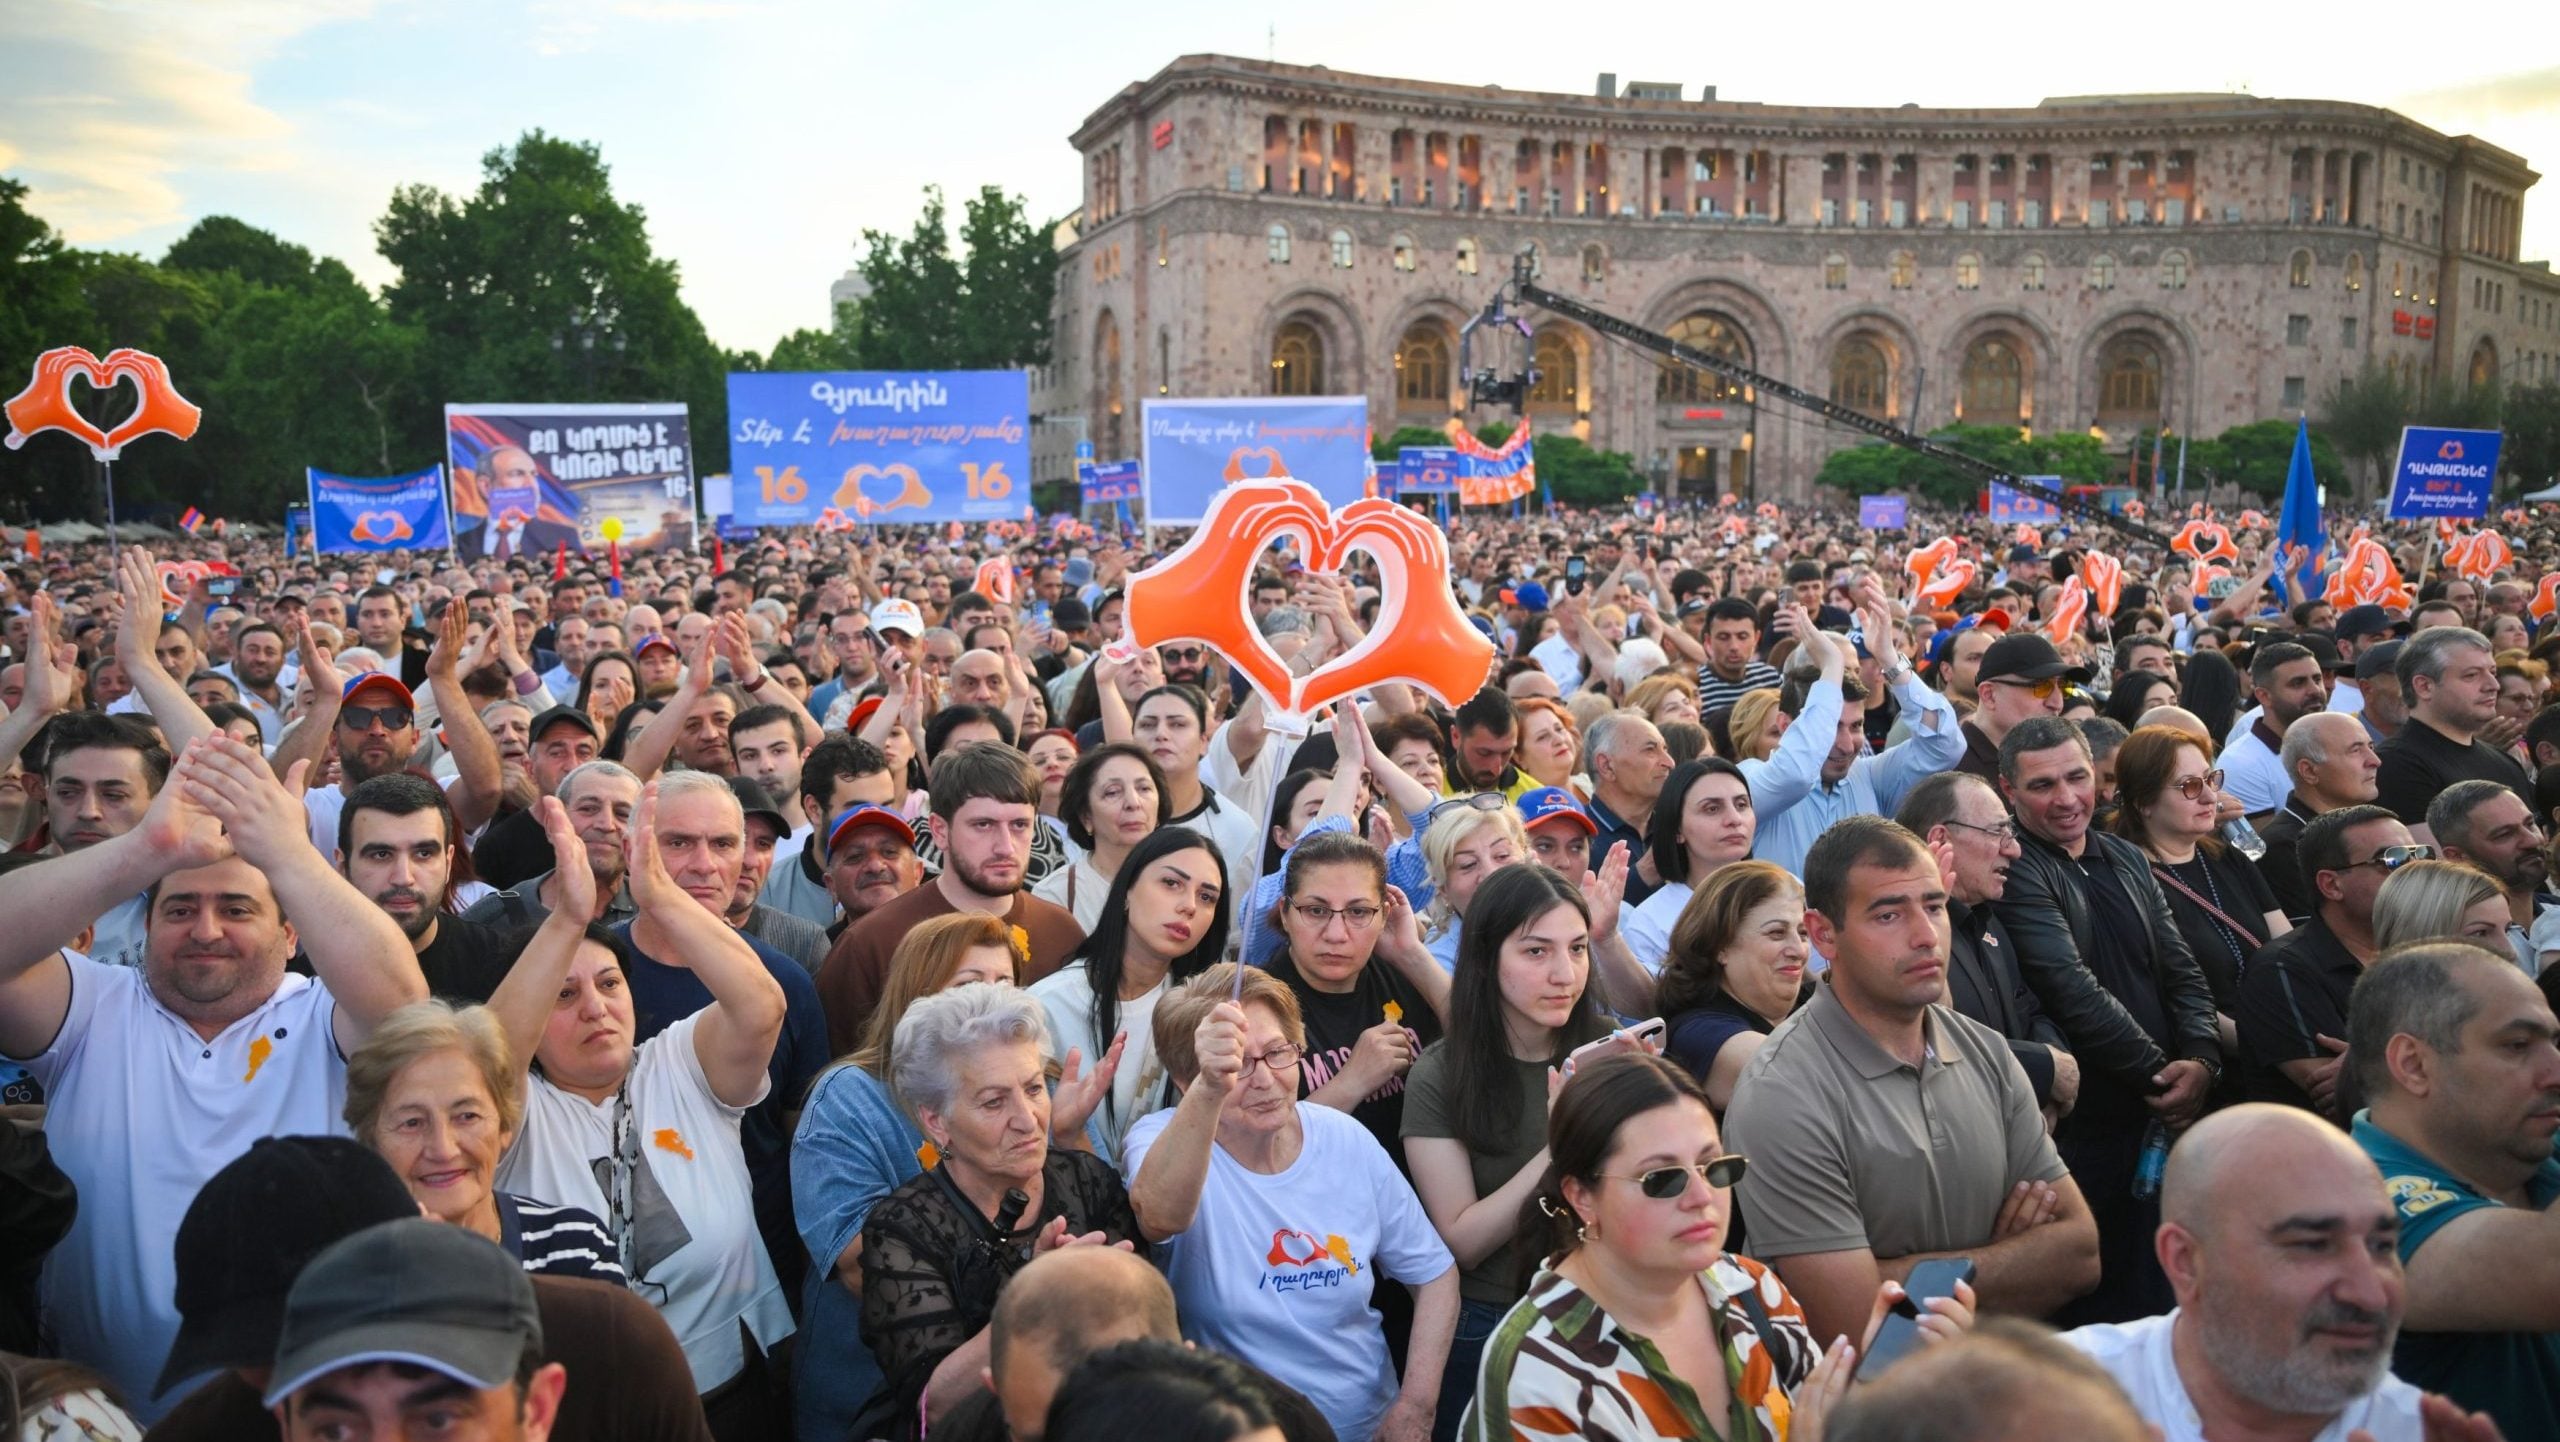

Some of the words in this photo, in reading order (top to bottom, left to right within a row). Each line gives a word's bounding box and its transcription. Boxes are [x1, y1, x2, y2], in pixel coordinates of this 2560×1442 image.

[811, 379, 948, 414] Գյումրին
[735, 418, 783, 448] Տեր
[662, 475, 688, 499] 16
[754, 465, 809, 505] 16
[960, 461, 1012, 500] 16
